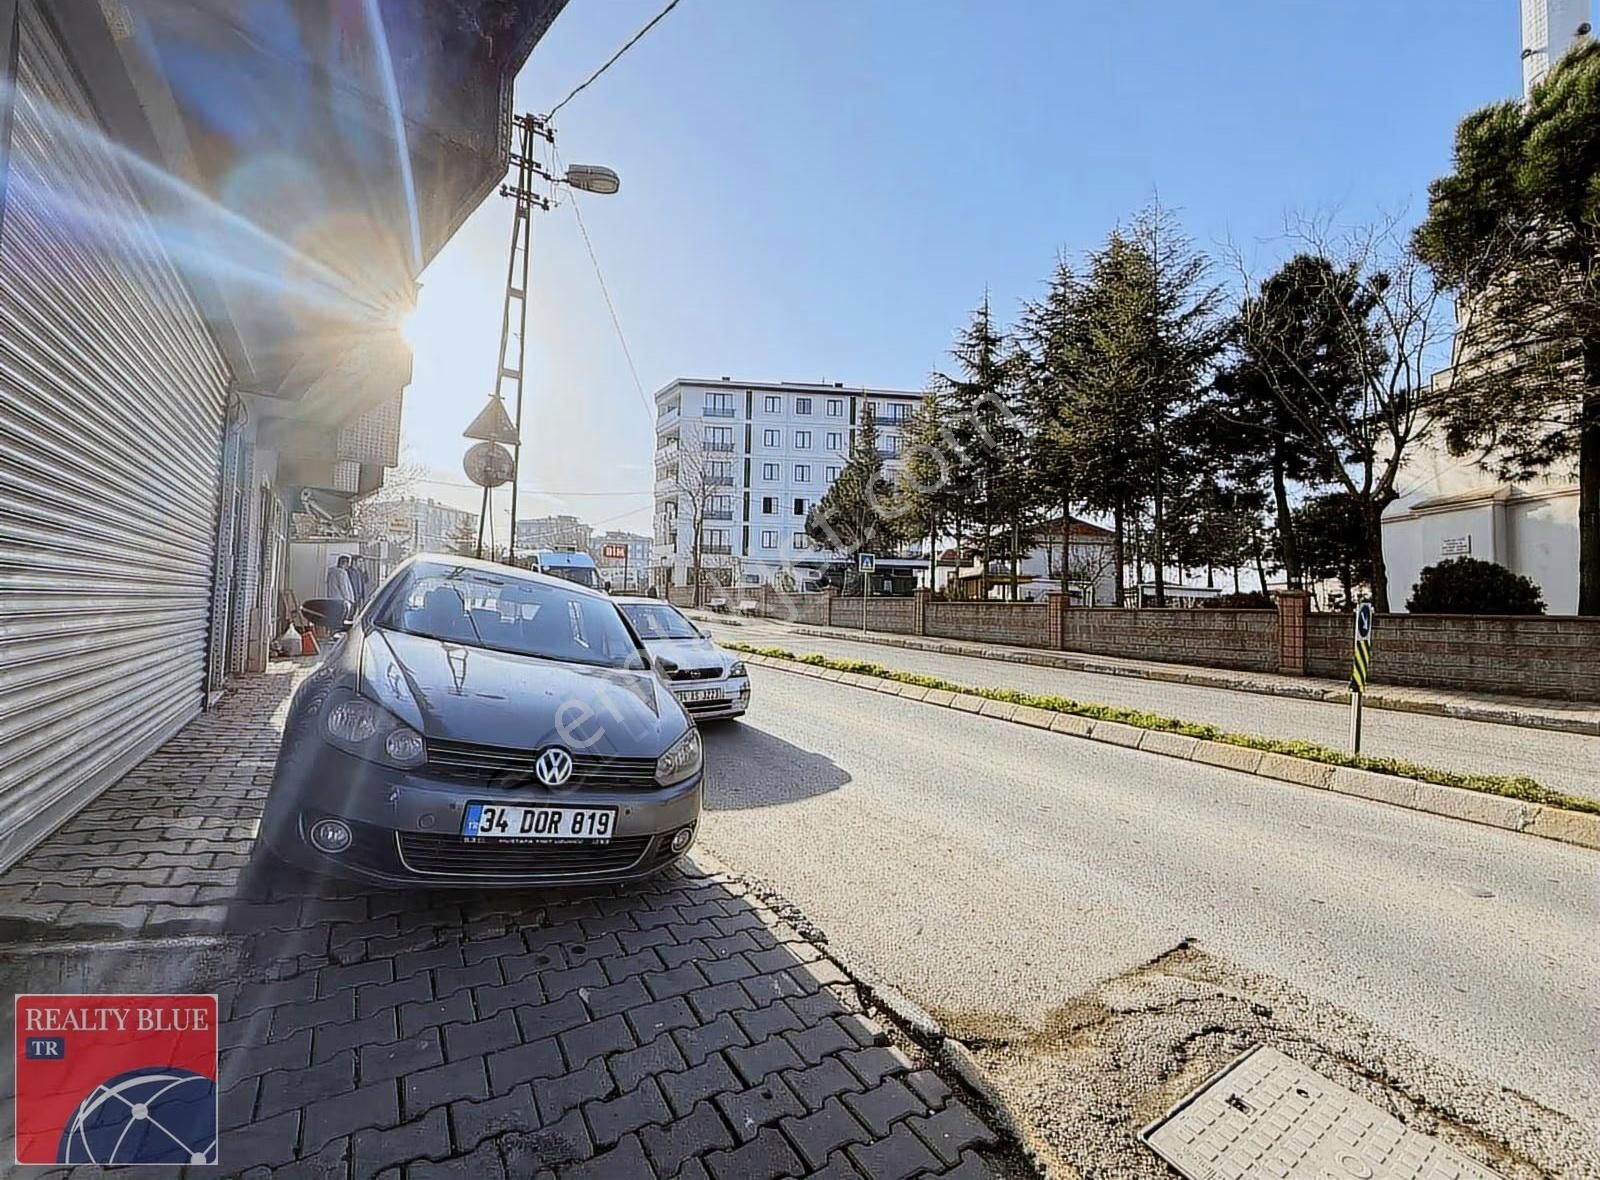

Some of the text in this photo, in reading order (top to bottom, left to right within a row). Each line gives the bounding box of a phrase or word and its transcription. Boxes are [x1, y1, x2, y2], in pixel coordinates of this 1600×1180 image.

[480, 808, 610, 835] 34 DOR 819
